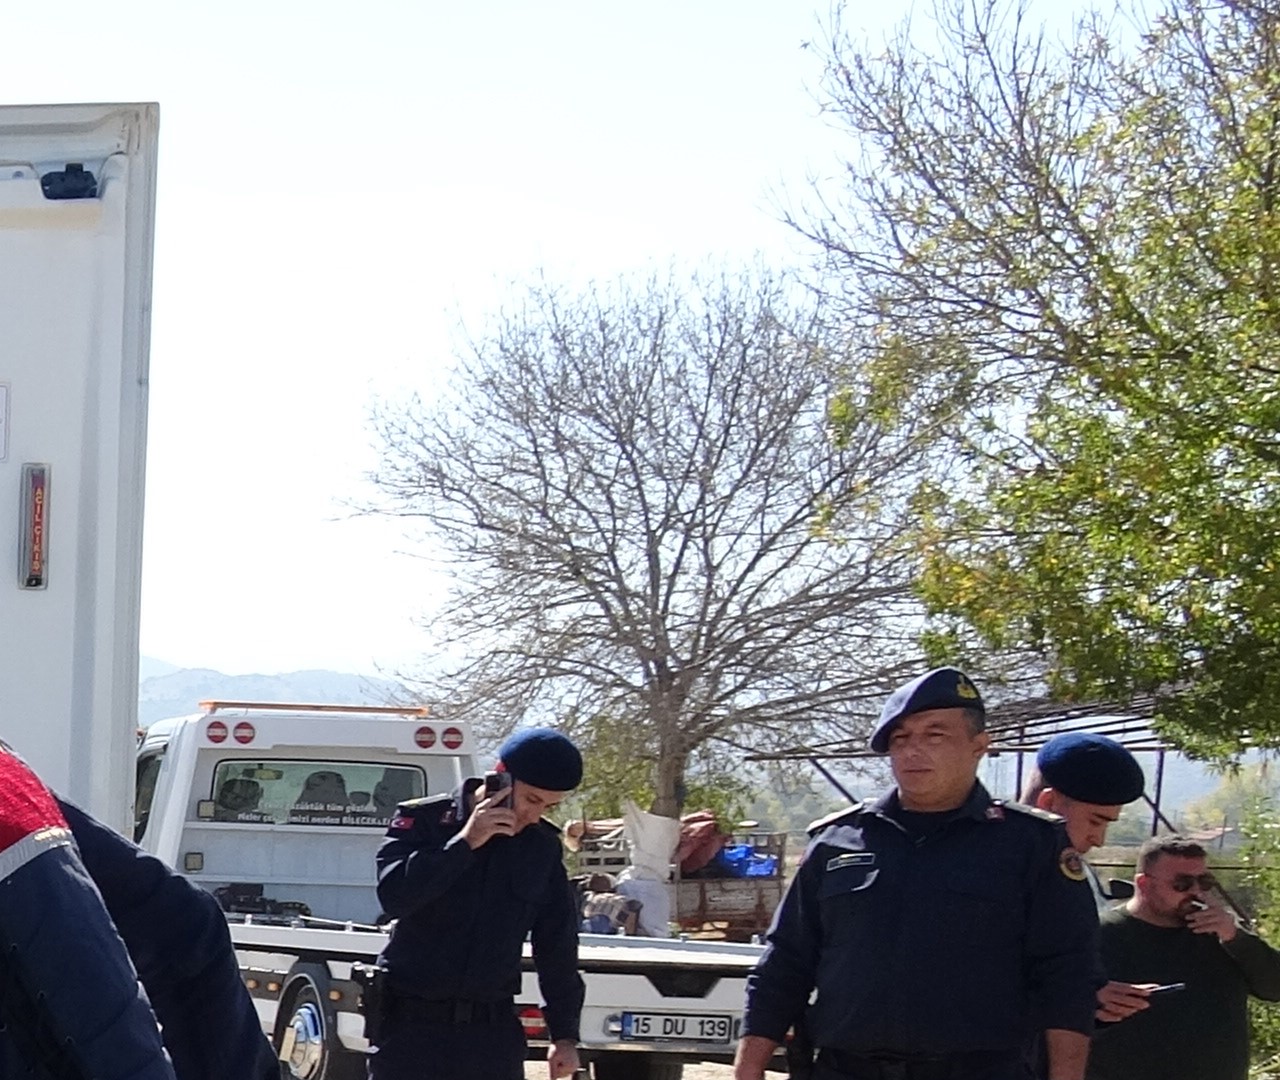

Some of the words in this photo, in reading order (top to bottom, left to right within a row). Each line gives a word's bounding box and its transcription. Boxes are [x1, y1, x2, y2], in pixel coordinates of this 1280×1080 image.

[633, 1017, 651, 1035] 15
[662, 1018, 686, 1036] DU
[698, 1019, 727, 1037] 139
